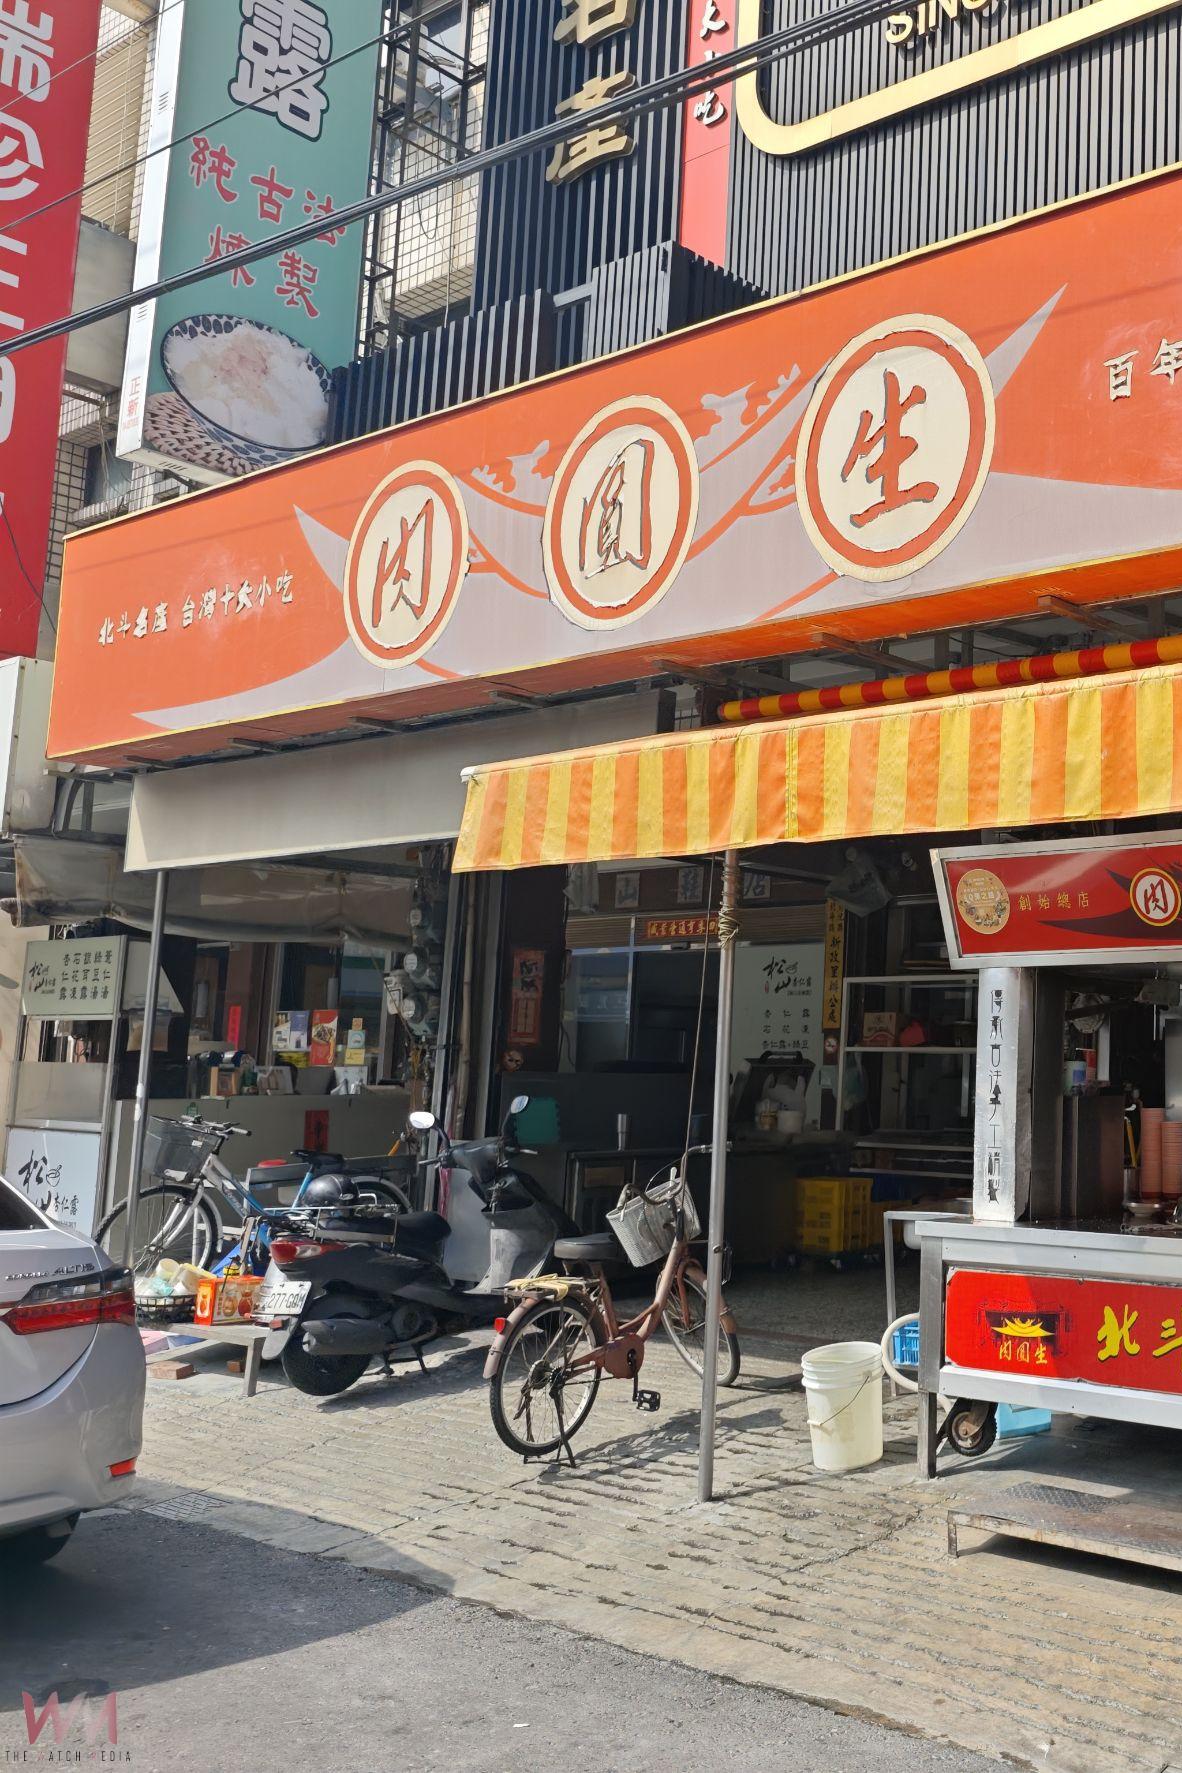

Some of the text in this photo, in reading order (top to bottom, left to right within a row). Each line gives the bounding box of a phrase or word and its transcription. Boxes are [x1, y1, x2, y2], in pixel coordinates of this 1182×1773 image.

[1018, 891, 1090, 911] 創始總店
[999, 1339, 1048, 1365] 肉圓生
